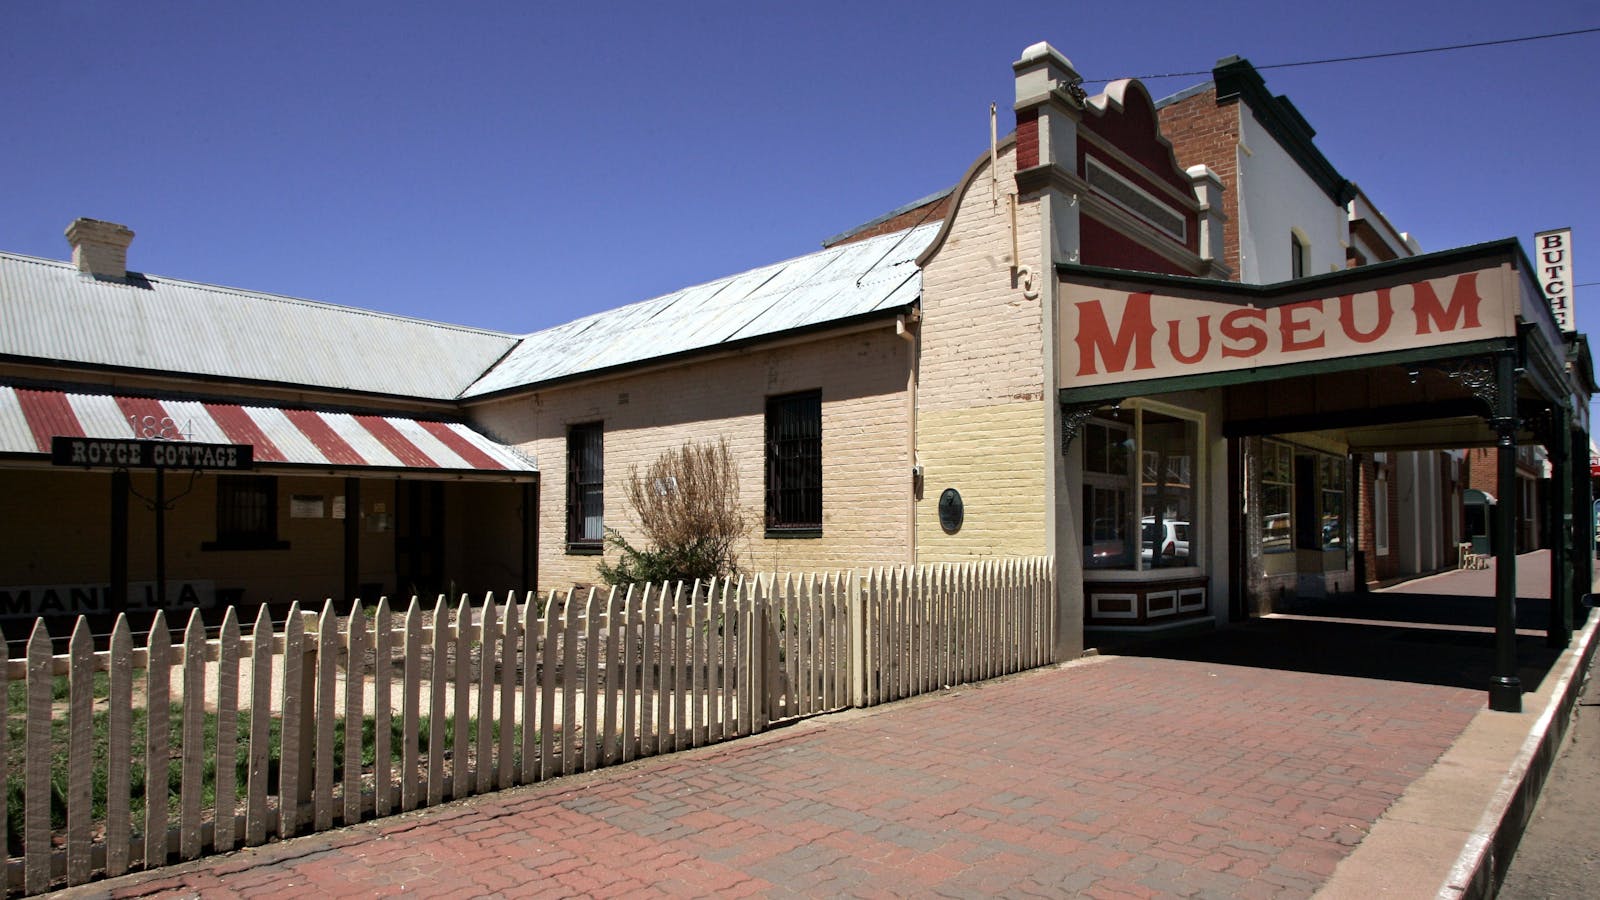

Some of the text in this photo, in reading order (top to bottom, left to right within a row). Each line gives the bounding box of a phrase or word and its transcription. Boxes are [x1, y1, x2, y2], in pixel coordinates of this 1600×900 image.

[1542, 235, 1567, 331] BUTCH
[1074, 272, 1482, 376] MUSEUM
[130, 415, 195, 443] 1884
[72, 441, 237, 467] ROYCE COTTAGE
[0, 584, 200, 613] MANILA
